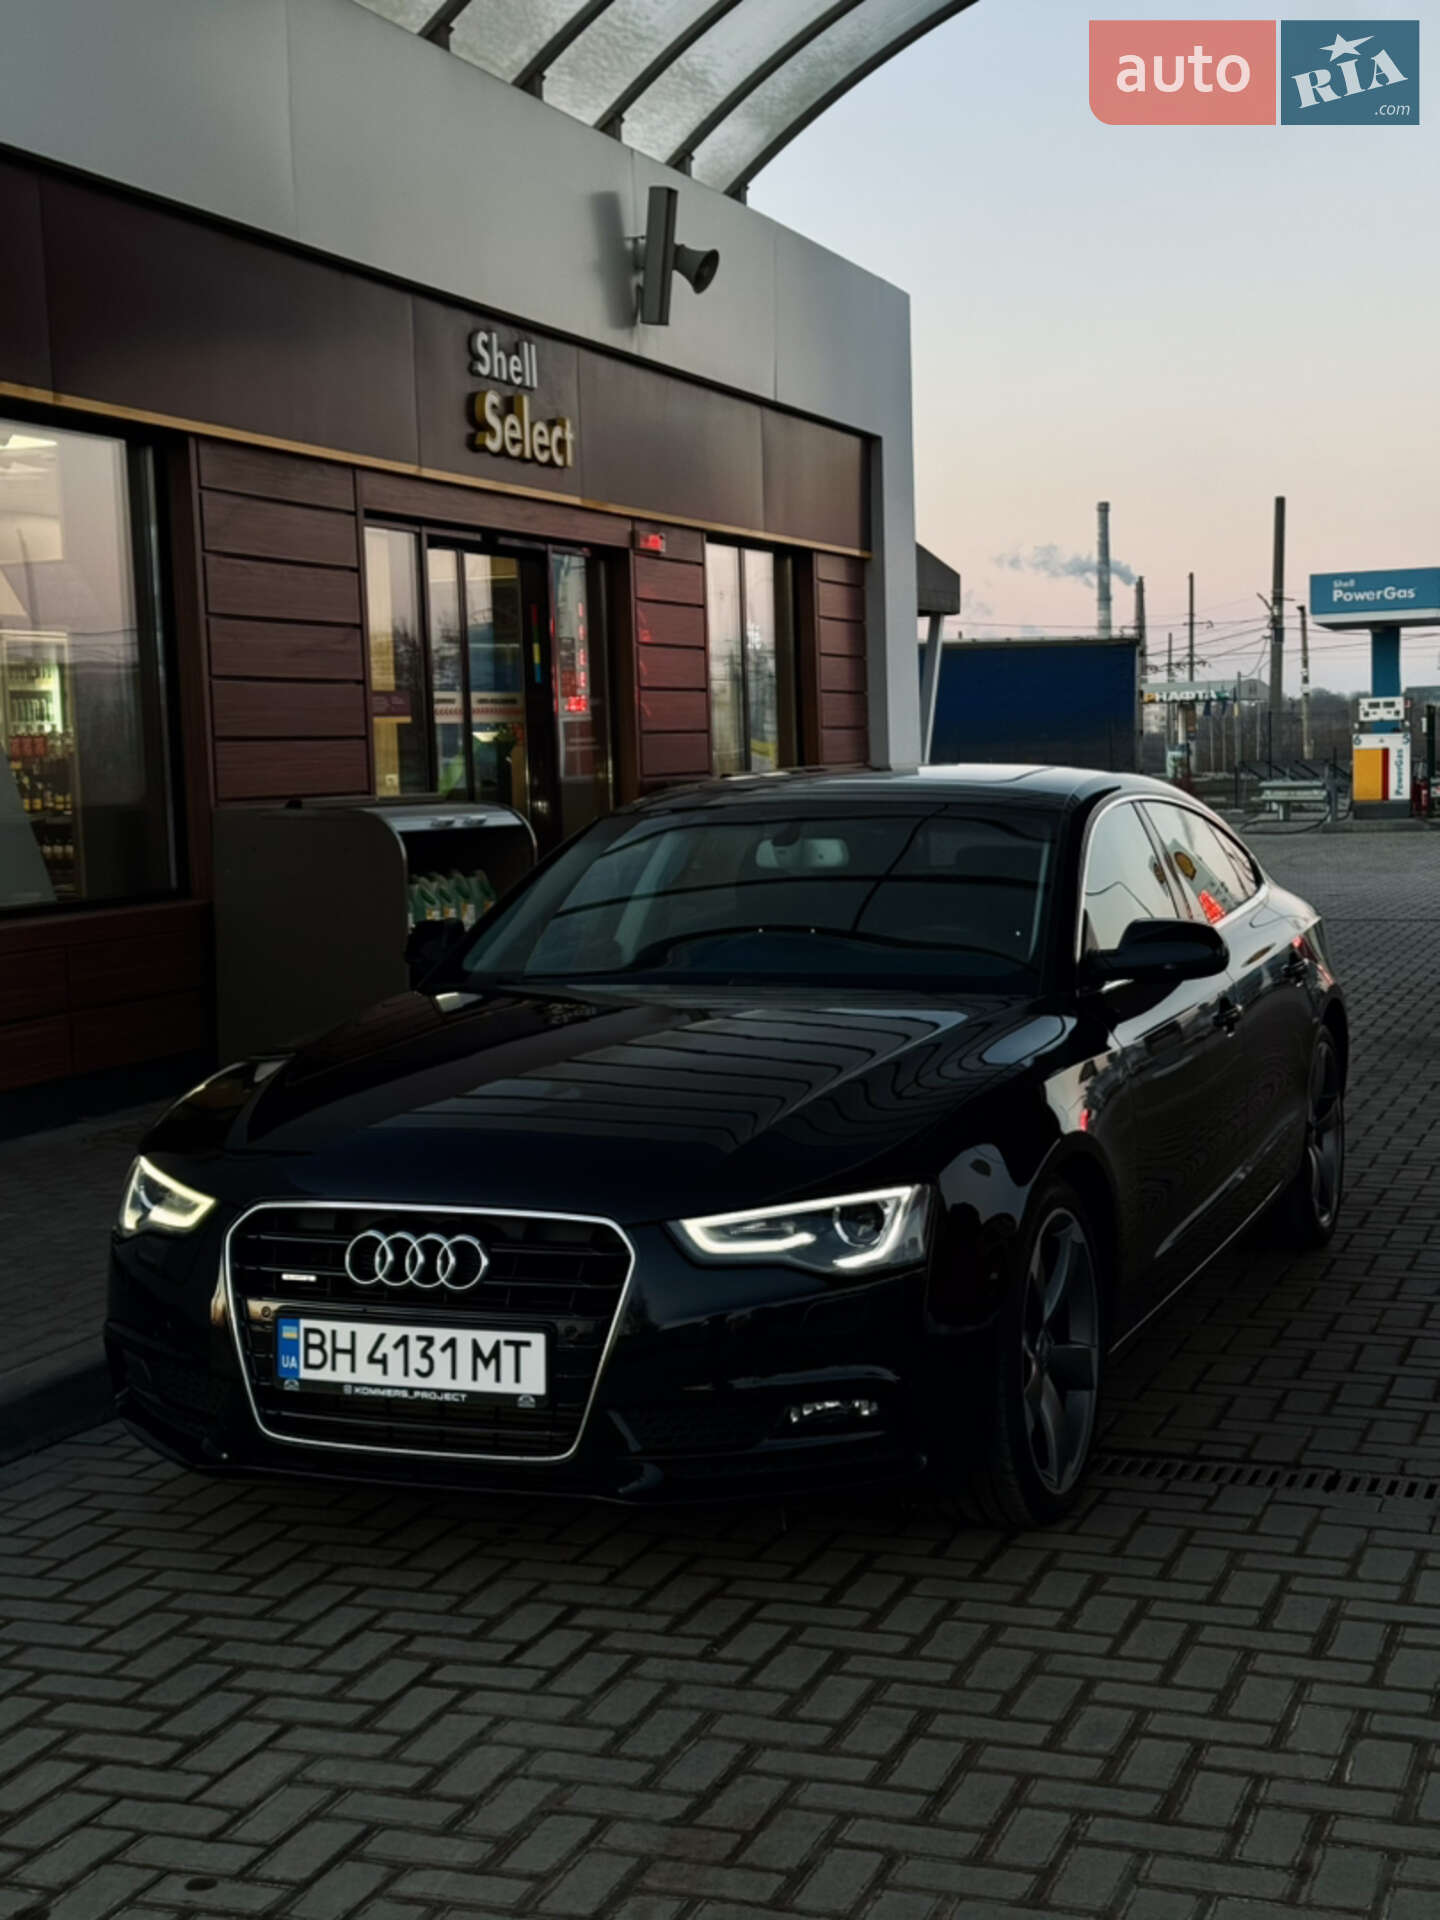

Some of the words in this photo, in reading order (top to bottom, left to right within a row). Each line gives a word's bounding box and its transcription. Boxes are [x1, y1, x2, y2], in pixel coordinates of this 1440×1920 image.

[475, 331, 538, 388] Shell
[482, 390, 575, 467] Select
[1332, 586, 1416, 602] PowerGas
[281, 1355, 297, 1369] UA
[303, 1327, 357, 1373] BH
[367, 1332, 457, 1381] 4131
[471, 1338, 532, 1384] MT
